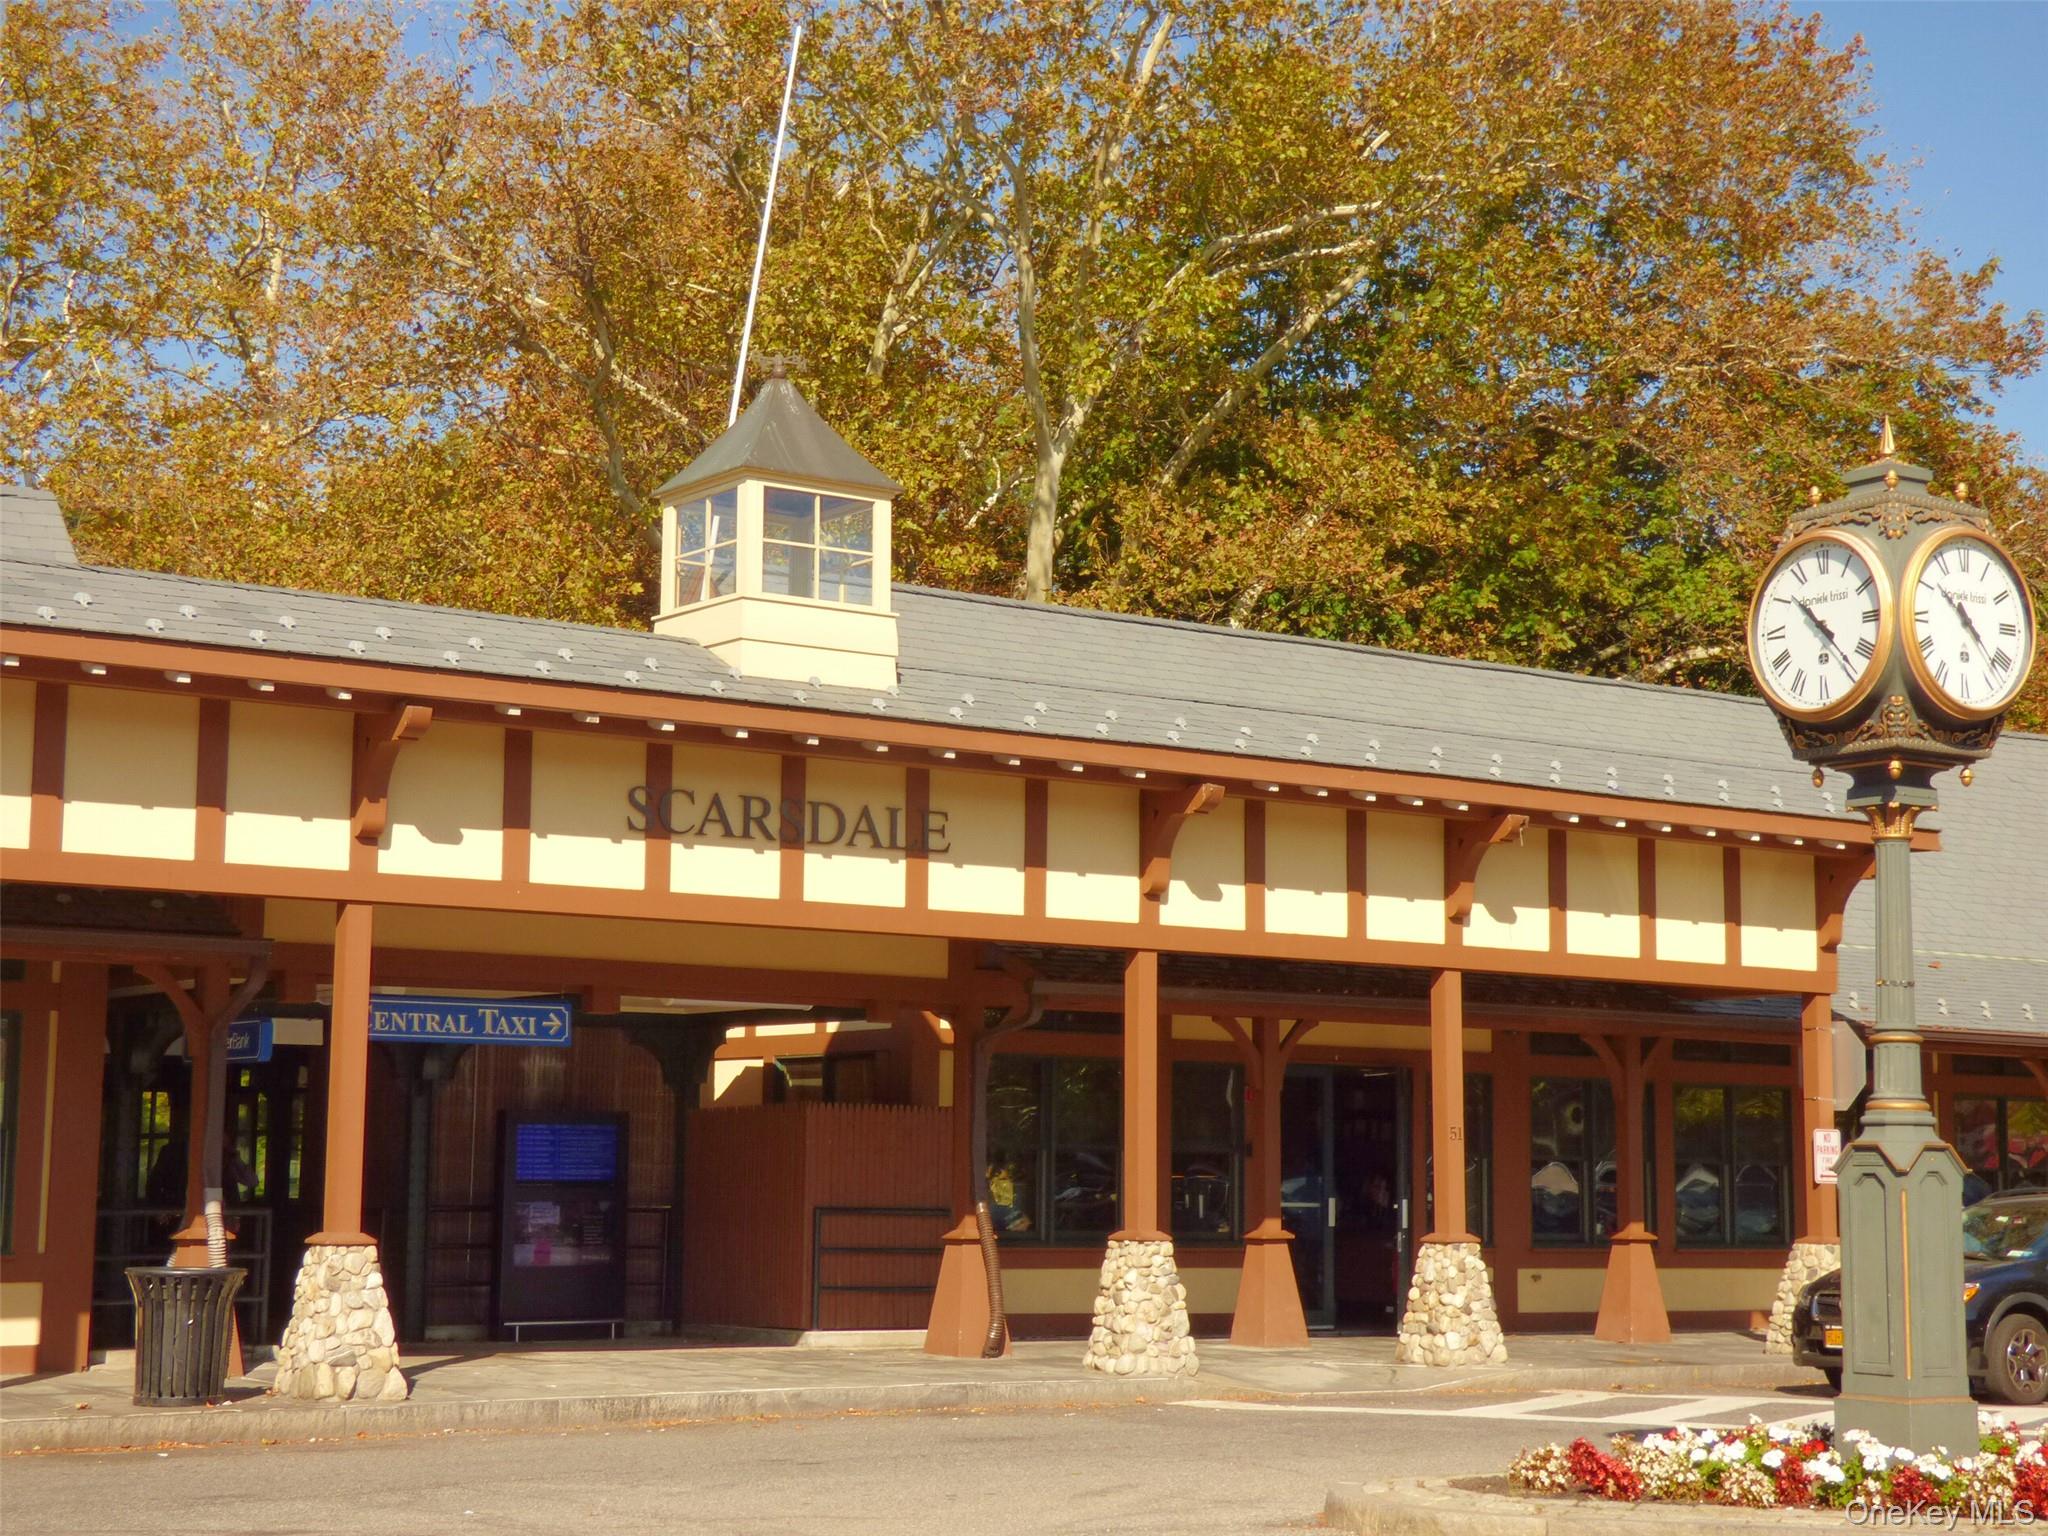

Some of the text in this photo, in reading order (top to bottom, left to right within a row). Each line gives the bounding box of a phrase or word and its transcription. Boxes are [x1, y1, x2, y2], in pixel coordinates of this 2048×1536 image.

[626, 785, 951, 854] SCARSDALE
[369, 1003, 537, 1036] ENTRAL TAXI
[1449, 1126, 1463, 1141] 51
[1823, 1133, 1832, 1143] NO
[1816, 1145, 1839, 1155] PARKING
